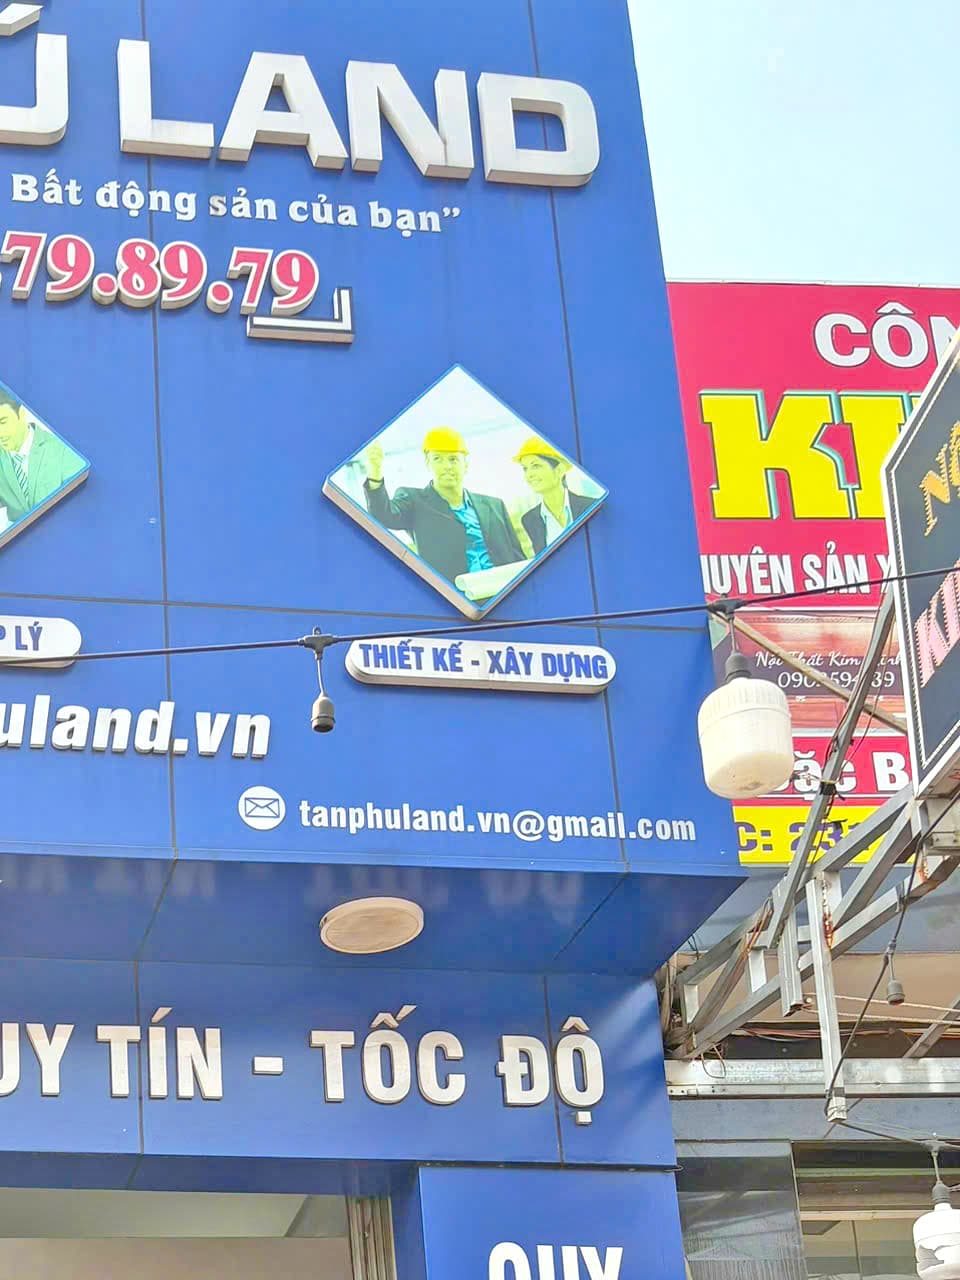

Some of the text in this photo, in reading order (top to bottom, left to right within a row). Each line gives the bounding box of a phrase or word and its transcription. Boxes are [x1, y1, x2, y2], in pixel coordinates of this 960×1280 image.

[116, 39, 602, 187] LAND
[11, 168, 84, 207] Bất
[95, 180, 197, 222] động
[209, 187, 278, 221] sản
[288, 193, 359, 227] của
[801, 541, 871, 595] SẢN
[15, 620, 44, 652] LÝ
[358, 638, 609, 683] THIẾT KẾ - XÂY DỰNG
[828, 649, 861, 667] Kim
[298, 798, 697, 842] tanphuland.vn@gmail.com
[95, 1007, 225, 1101] TÍN
[252, 1056, 285, 1076] -
[309, 1004, 466, 1106] TỐC
[496, 1015, 605, 1126] ĐỘ
